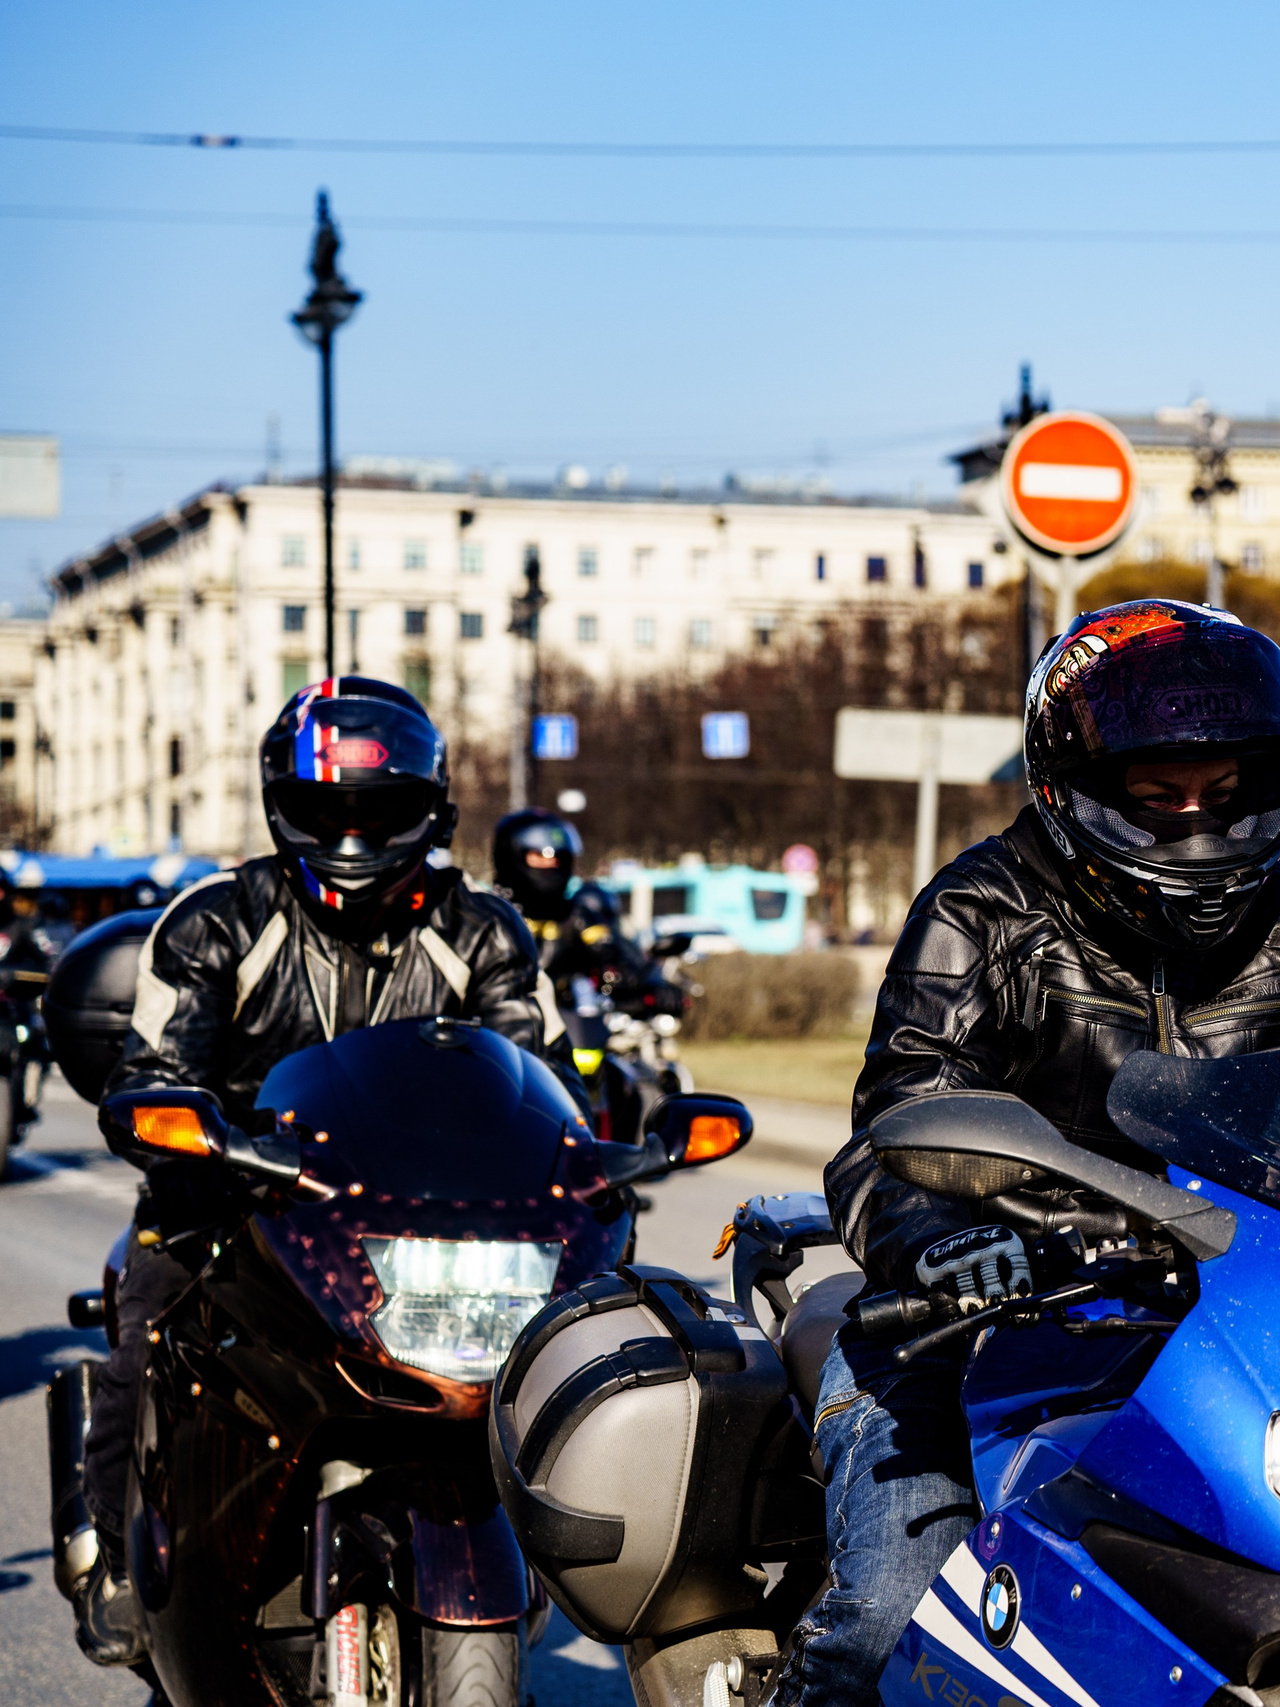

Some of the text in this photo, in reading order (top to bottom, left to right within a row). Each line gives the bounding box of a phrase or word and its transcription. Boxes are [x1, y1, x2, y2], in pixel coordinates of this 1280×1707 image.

[1166, 692, 1243, 719] SHOEI
[325, 745, 380, 763] SHOEI
[989, 1569, 1017, 1604] BMW
[337, 1605, 360, 1696] SHOWA
